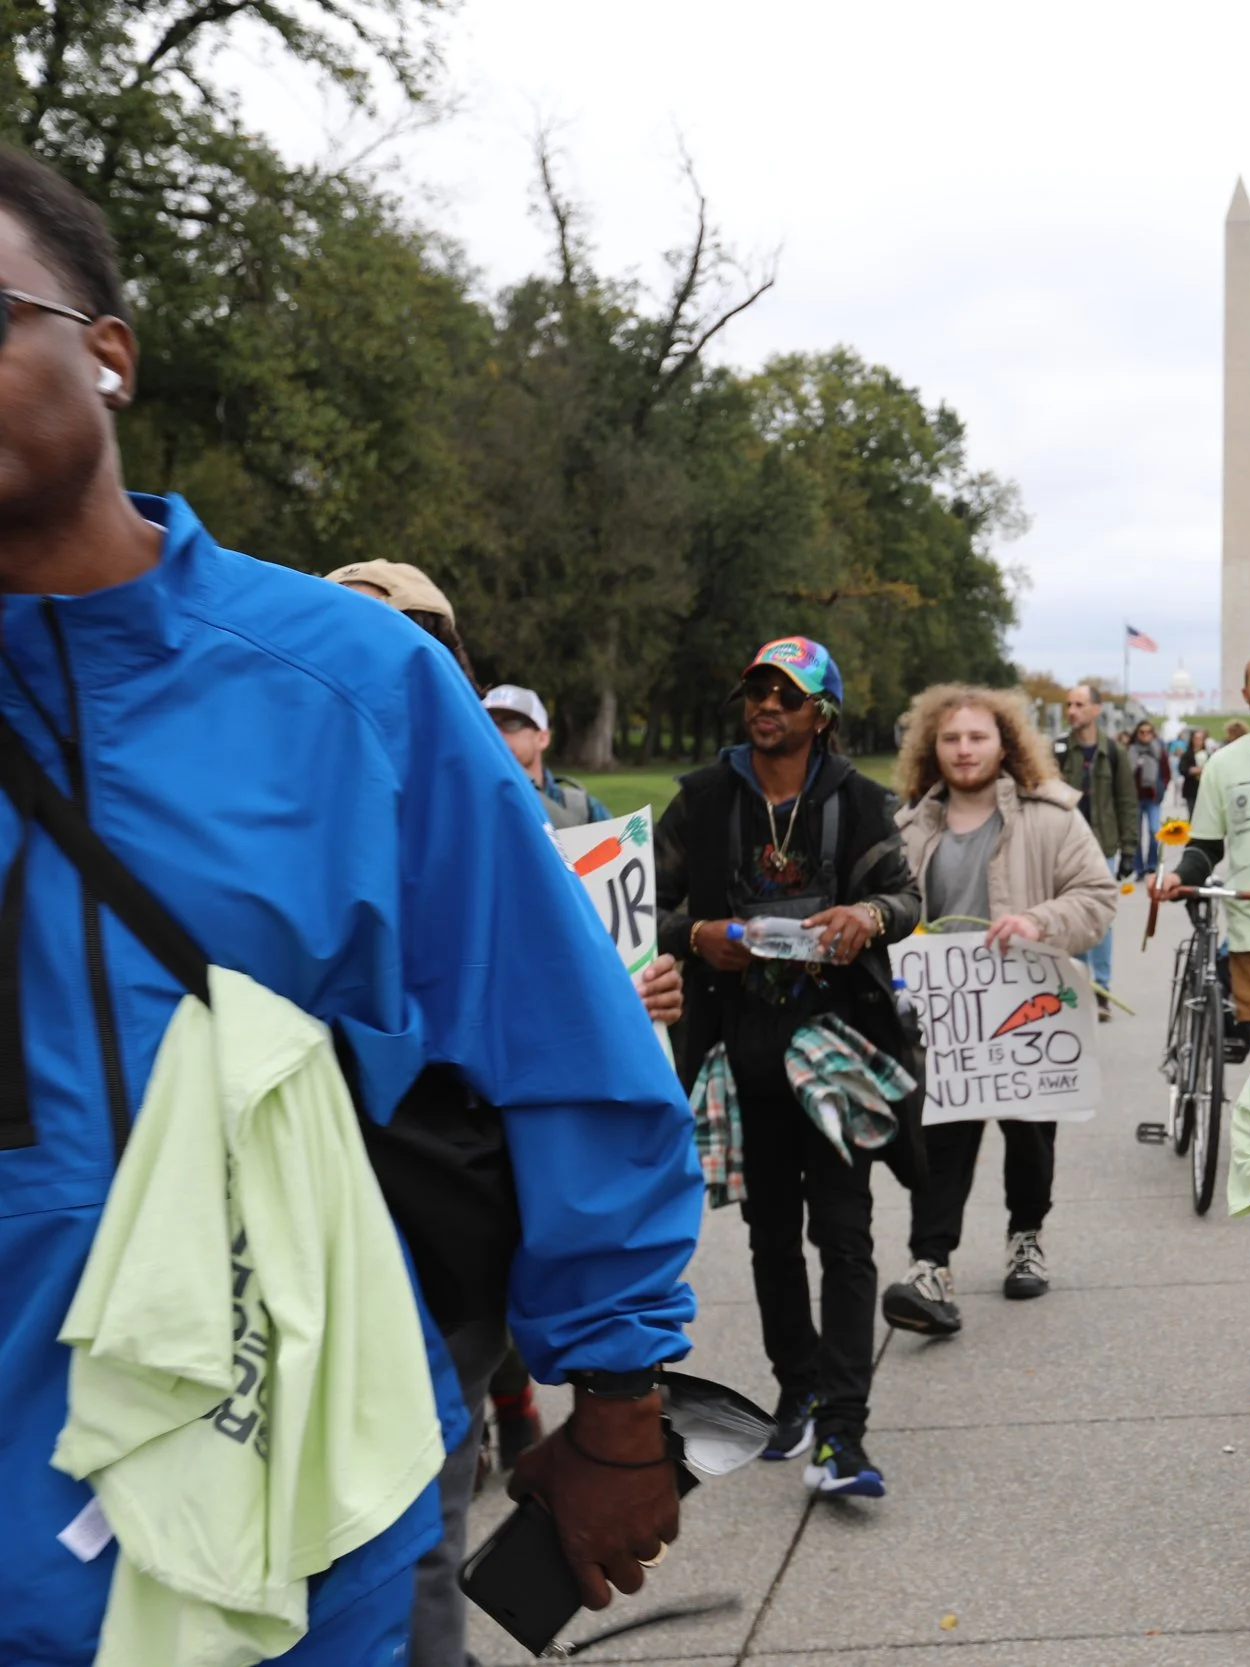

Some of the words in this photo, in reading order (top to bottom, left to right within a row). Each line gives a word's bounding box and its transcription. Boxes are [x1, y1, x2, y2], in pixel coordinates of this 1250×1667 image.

[900, 945, 1066, 993] CLOSEST
[988, 1047, 1005, 1063] IS
[1011, 1030, 1083, 1067] 30
[1038, 1074, 1079, 1090] AWAY
